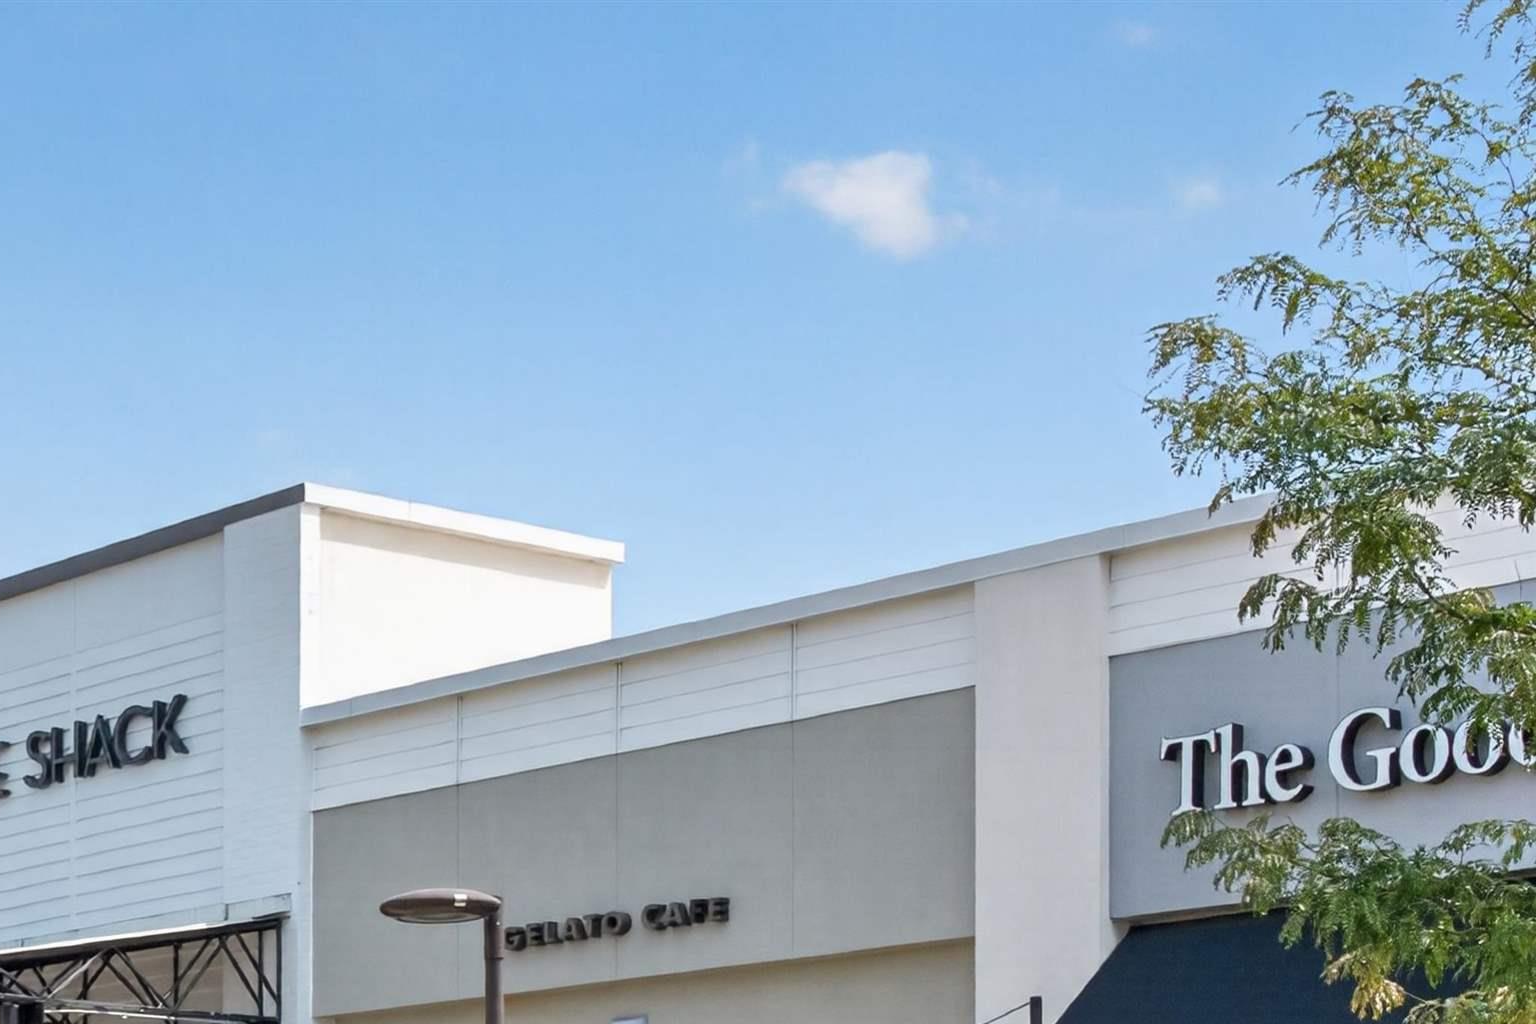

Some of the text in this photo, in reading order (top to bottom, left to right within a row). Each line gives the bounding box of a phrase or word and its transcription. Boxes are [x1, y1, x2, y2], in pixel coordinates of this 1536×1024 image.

[22, 694, 190, 789] SHACK
[1160, 722, 1314, 815] The
[504, 896, 731, 951] GELATO CAFE
